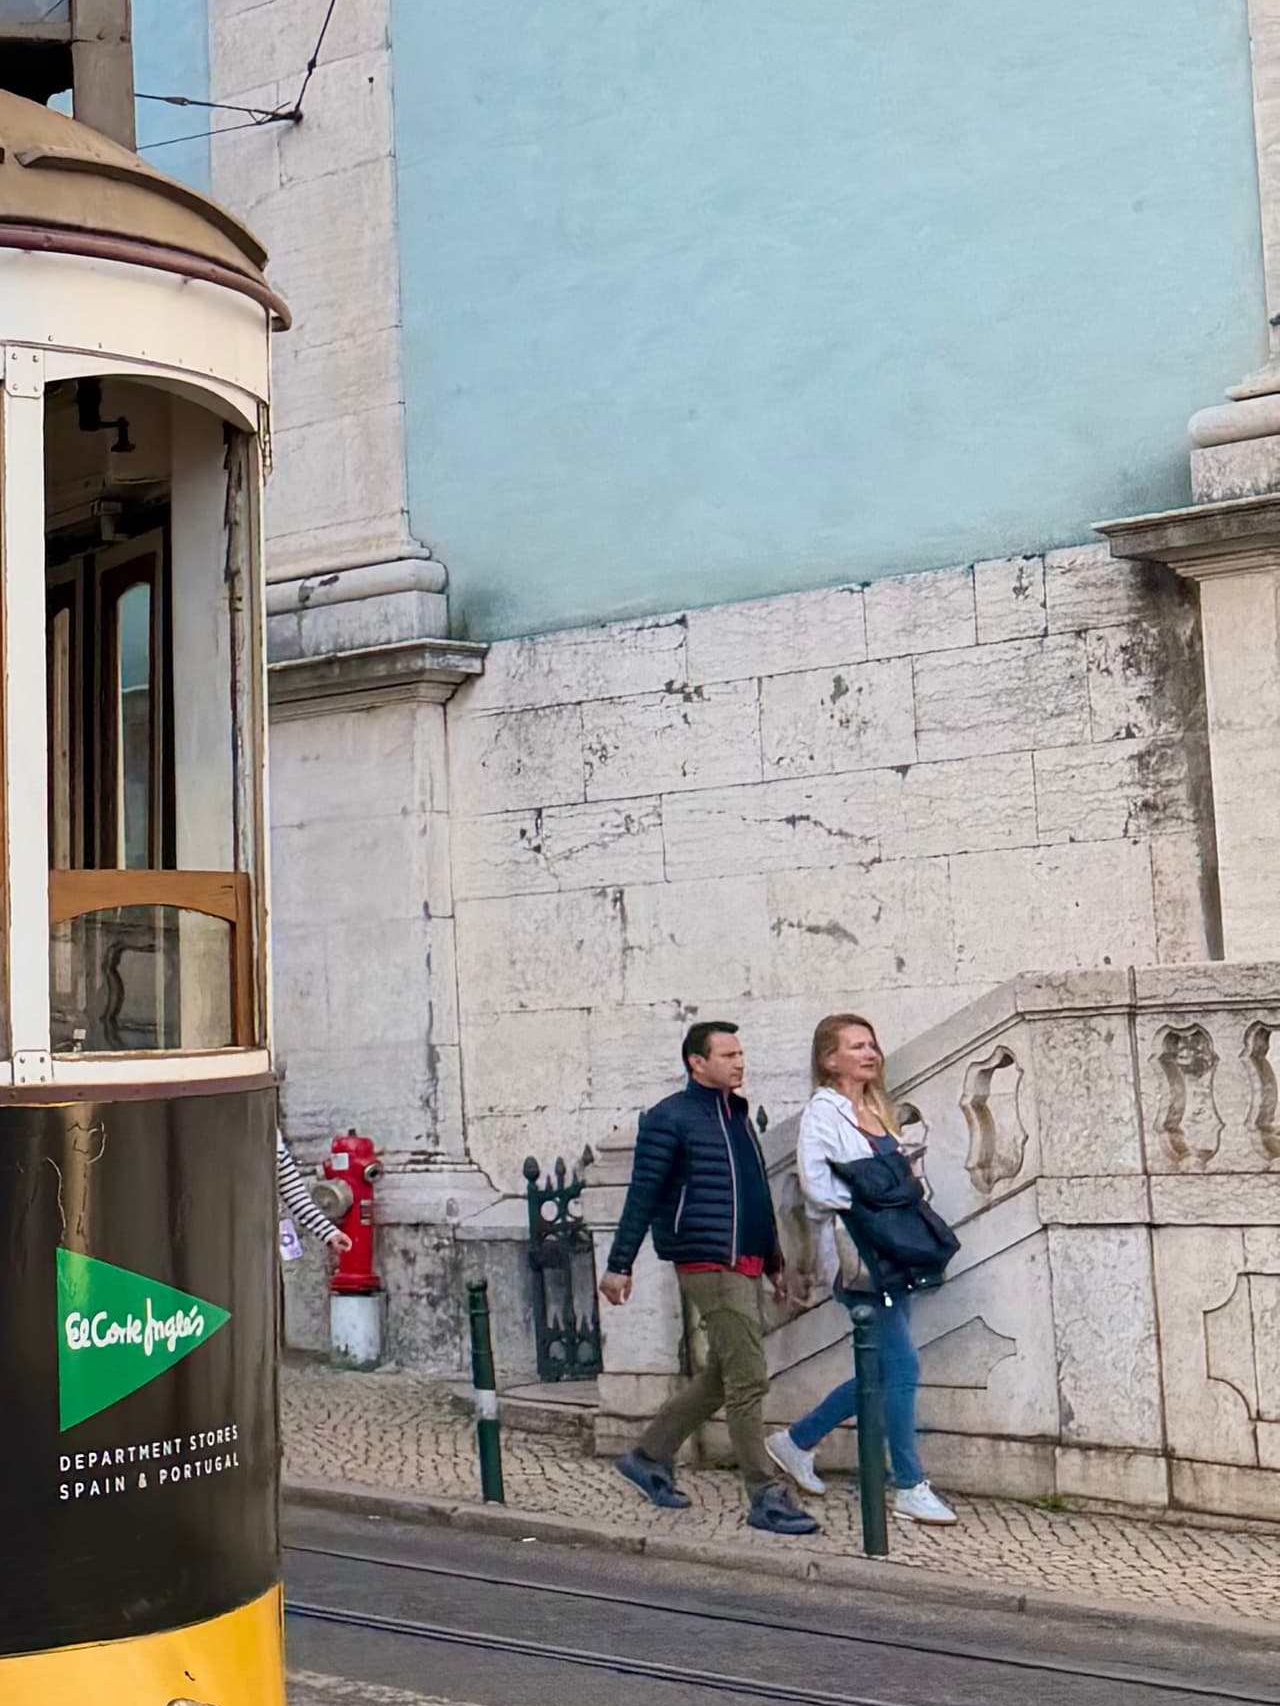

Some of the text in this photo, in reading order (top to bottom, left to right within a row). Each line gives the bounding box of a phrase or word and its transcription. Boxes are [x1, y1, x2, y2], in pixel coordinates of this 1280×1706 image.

[65, 1297, 205, 1357] El Corte Inglés
[59, 1424, 239, 1472] DEPARTMENT STORES
[59, 1452, 240, 1500] SPAIN & PORTUGAL
